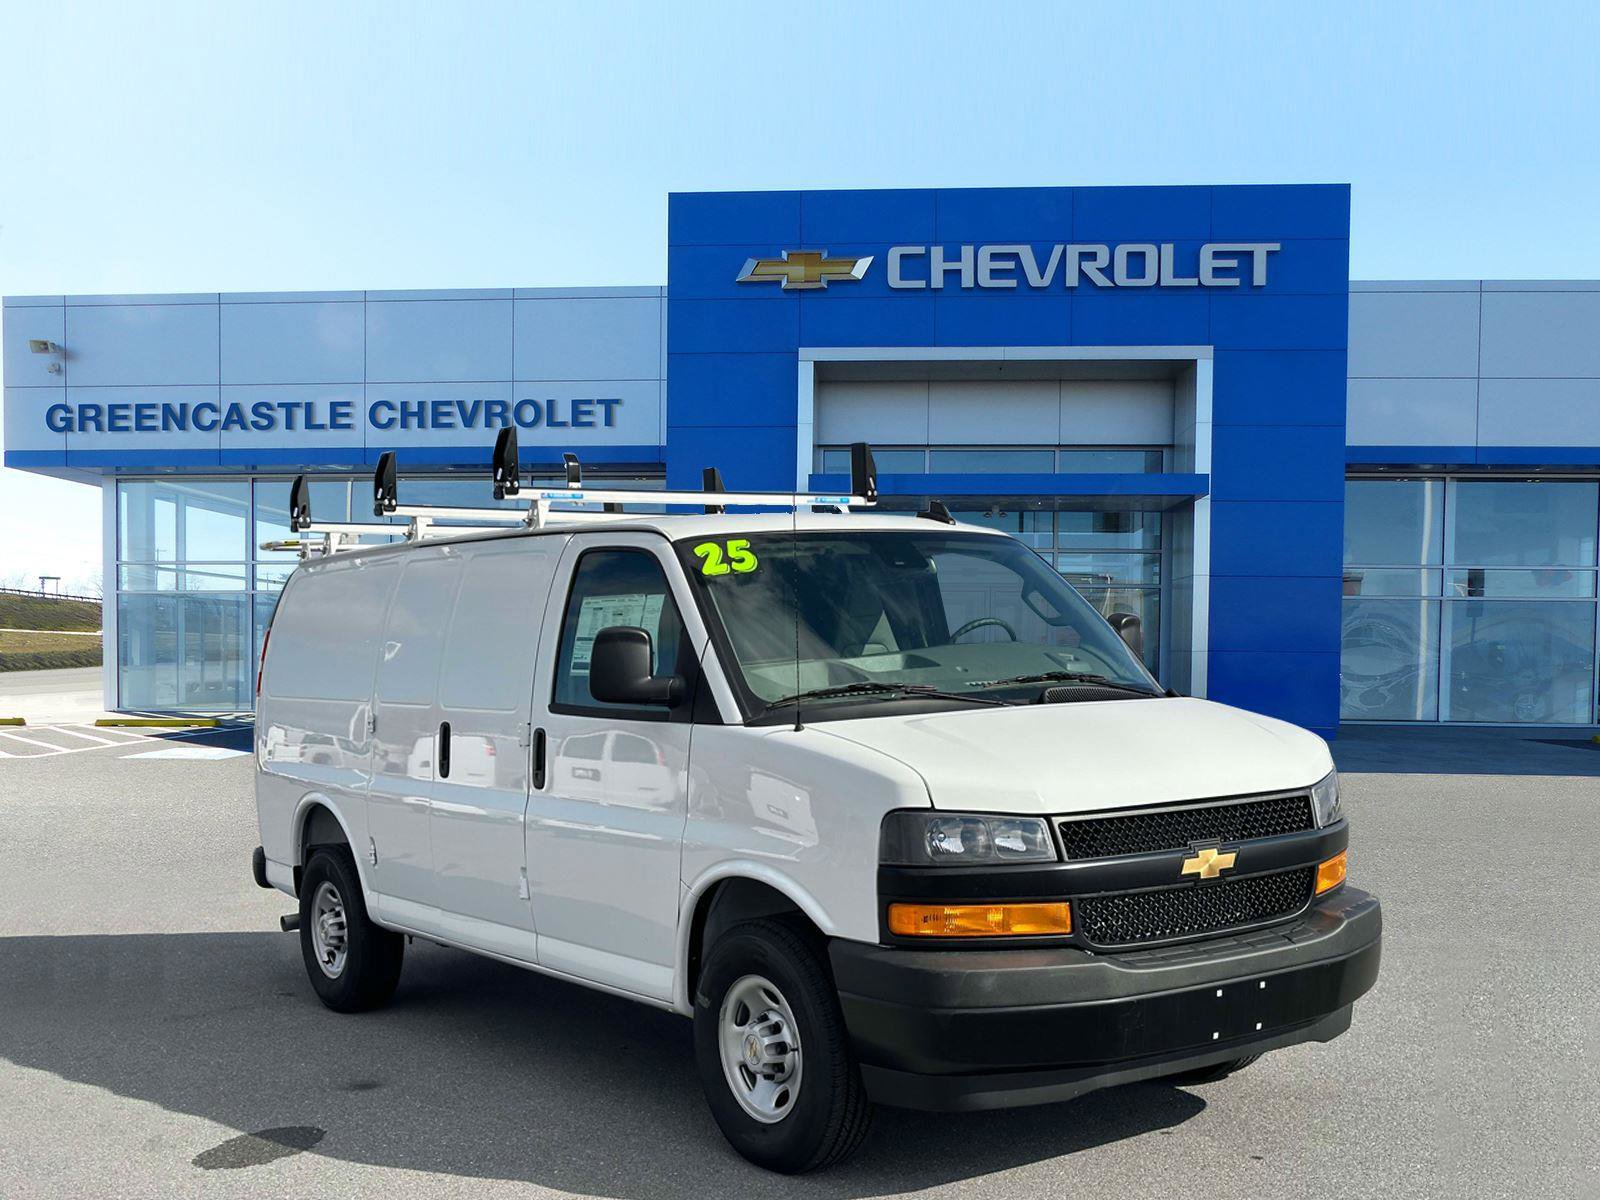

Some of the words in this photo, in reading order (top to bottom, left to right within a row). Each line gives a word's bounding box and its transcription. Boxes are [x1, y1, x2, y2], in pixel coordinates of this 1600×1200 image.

[887, 243, 1281, 289] CHEVROLET
[45, 401, 354, 433] GREENCASTLE
[368, 398, 622, 429] CHEVROLET
[693, 539, 758, 575] 25
